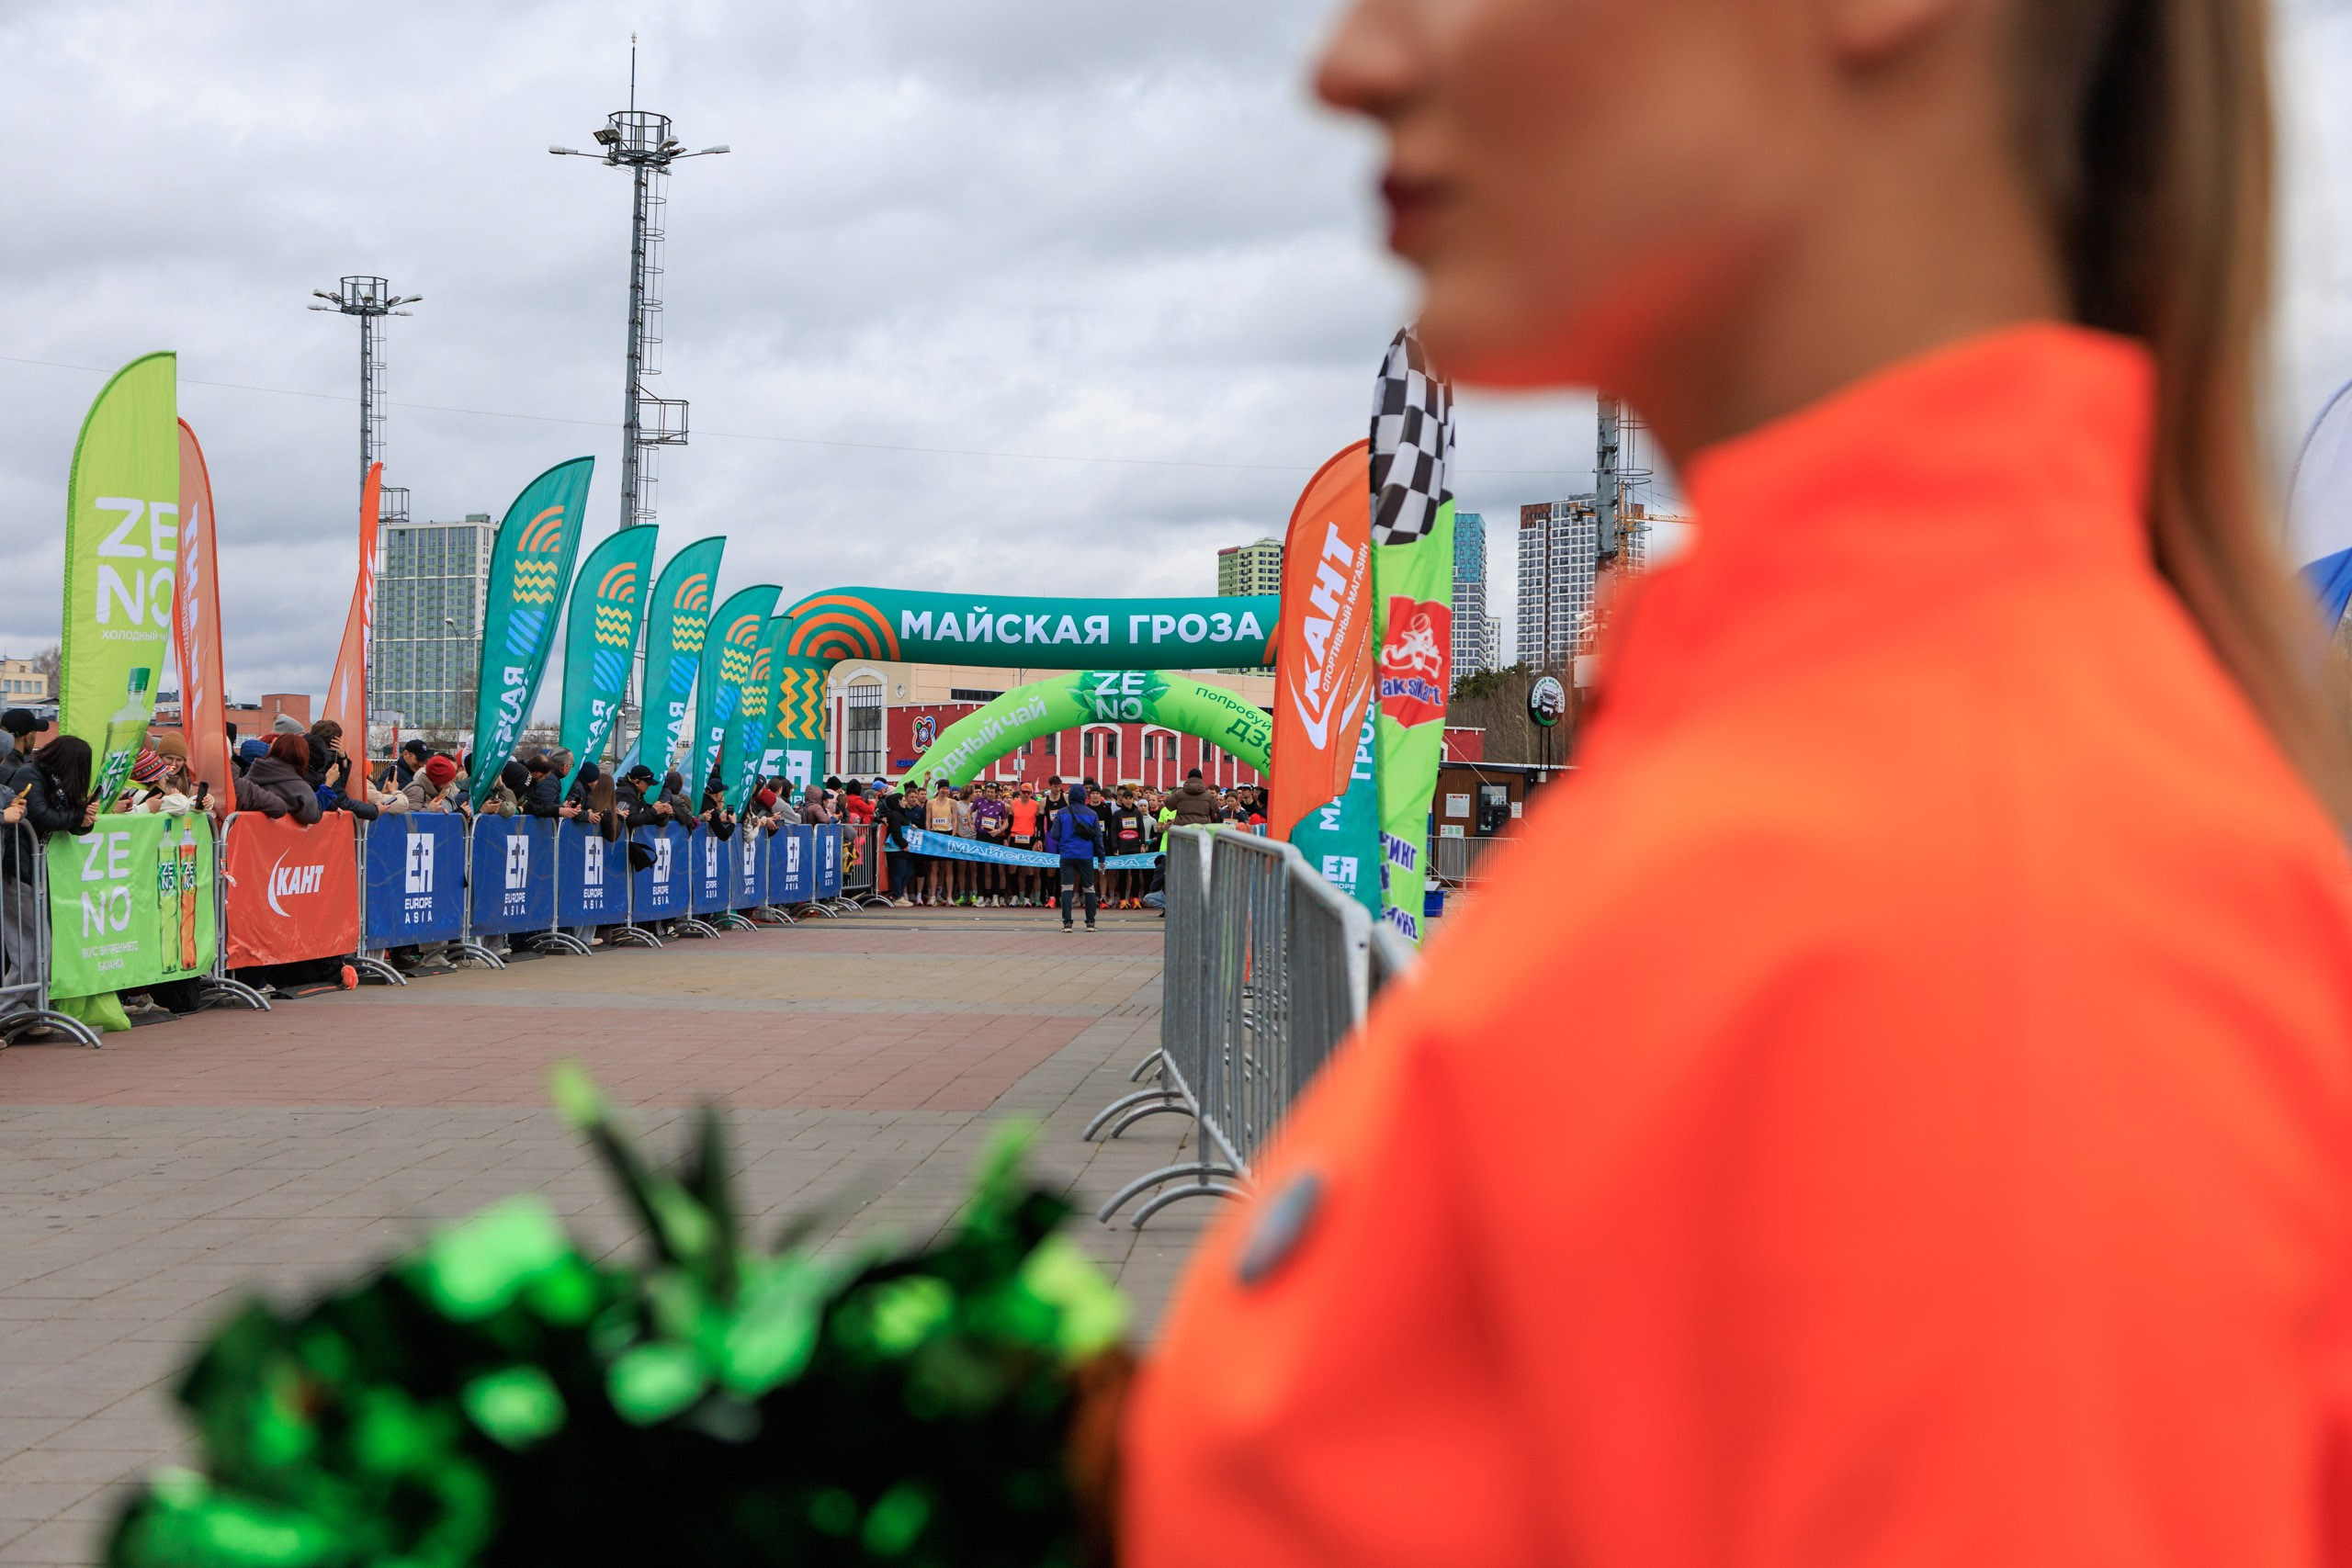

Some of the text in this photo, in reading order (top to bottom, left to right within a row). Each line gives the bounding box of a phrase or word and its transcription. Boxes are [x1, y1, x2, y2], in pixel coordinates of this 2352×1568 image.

[96, 497, 179, 562] ZE
[900, 606, 1265, 645] МАЙСКАЯ ГРОЗА
[1304, 521, 1354, 714] КАНТ
[1322, 604, 1353, 693] СПОРТИВНЫЙ
[1347, 542, 1369, 604] МАГАЗИН
[1092, 672, 1147, 696] ZE
[1096, 696, 1143, 720] NO
[78, 831, 130, 882] ZE
[277, 864, 324, 897] КАНТ
[652, 885, 669, 896] EUROPE
[404, 897, 433, 910] EUROPE
[504, 892, 526, 904] EUROPE
[582, 899, 604, 909] ASIA
[583, 888, 604, 898] EUROPE
[81, 886, 131, 939] NO
[404, 910, 433, 924] ASIA
[503, 905, 526, 917] ASIA
